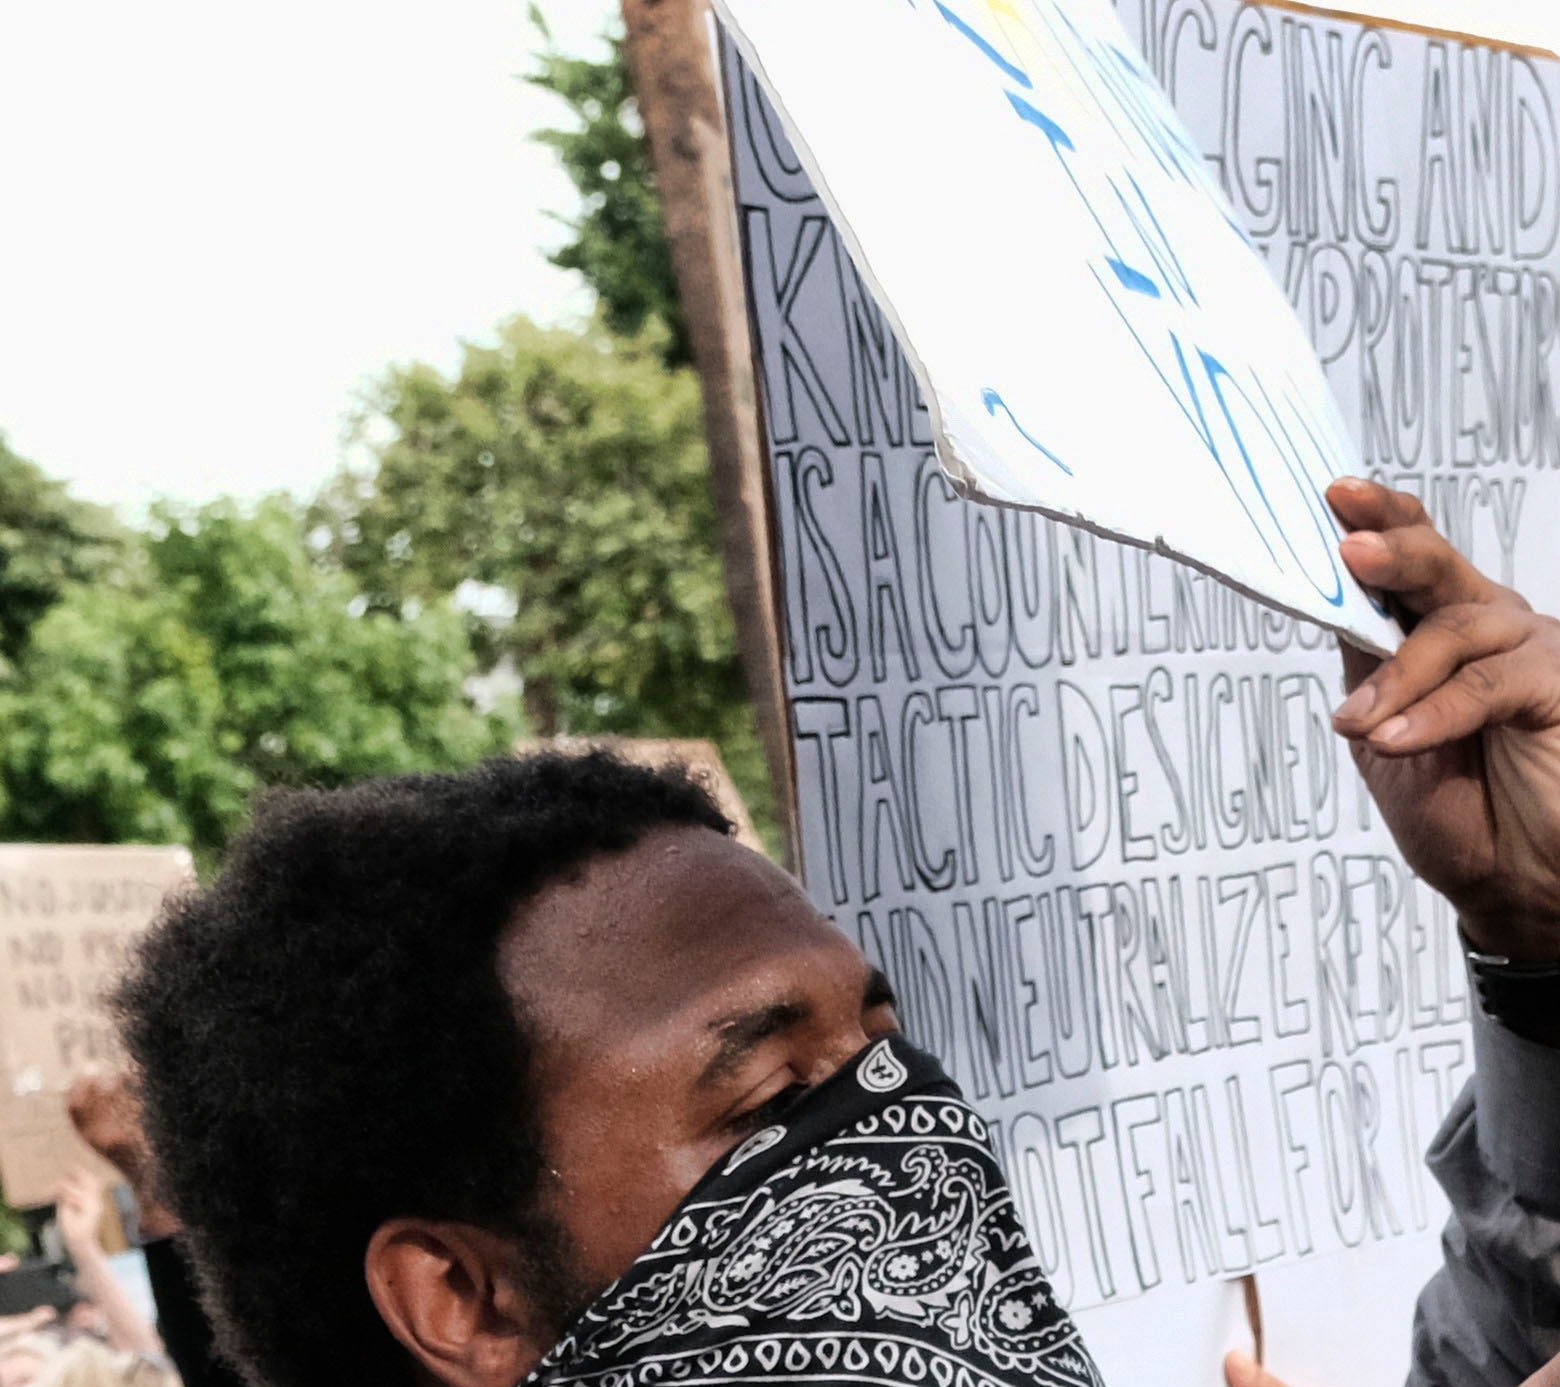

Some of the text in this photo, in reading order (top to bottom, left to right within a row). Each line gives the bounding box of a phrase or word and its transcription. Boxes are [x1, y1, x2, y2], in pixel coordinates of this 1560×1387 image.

[775, 448, 860, 687] IS
[858, 450, 922, 684] A
[792, 682, 1056, 905] TACTIC
[1054, 665, 1339, 872] DESIGNED
[952, 862, 1311, 1101] NEUTRALIZE
[1111, 1075, 1286, 1291] FALL
[1268, 1058, 1405, 1260] FOR
